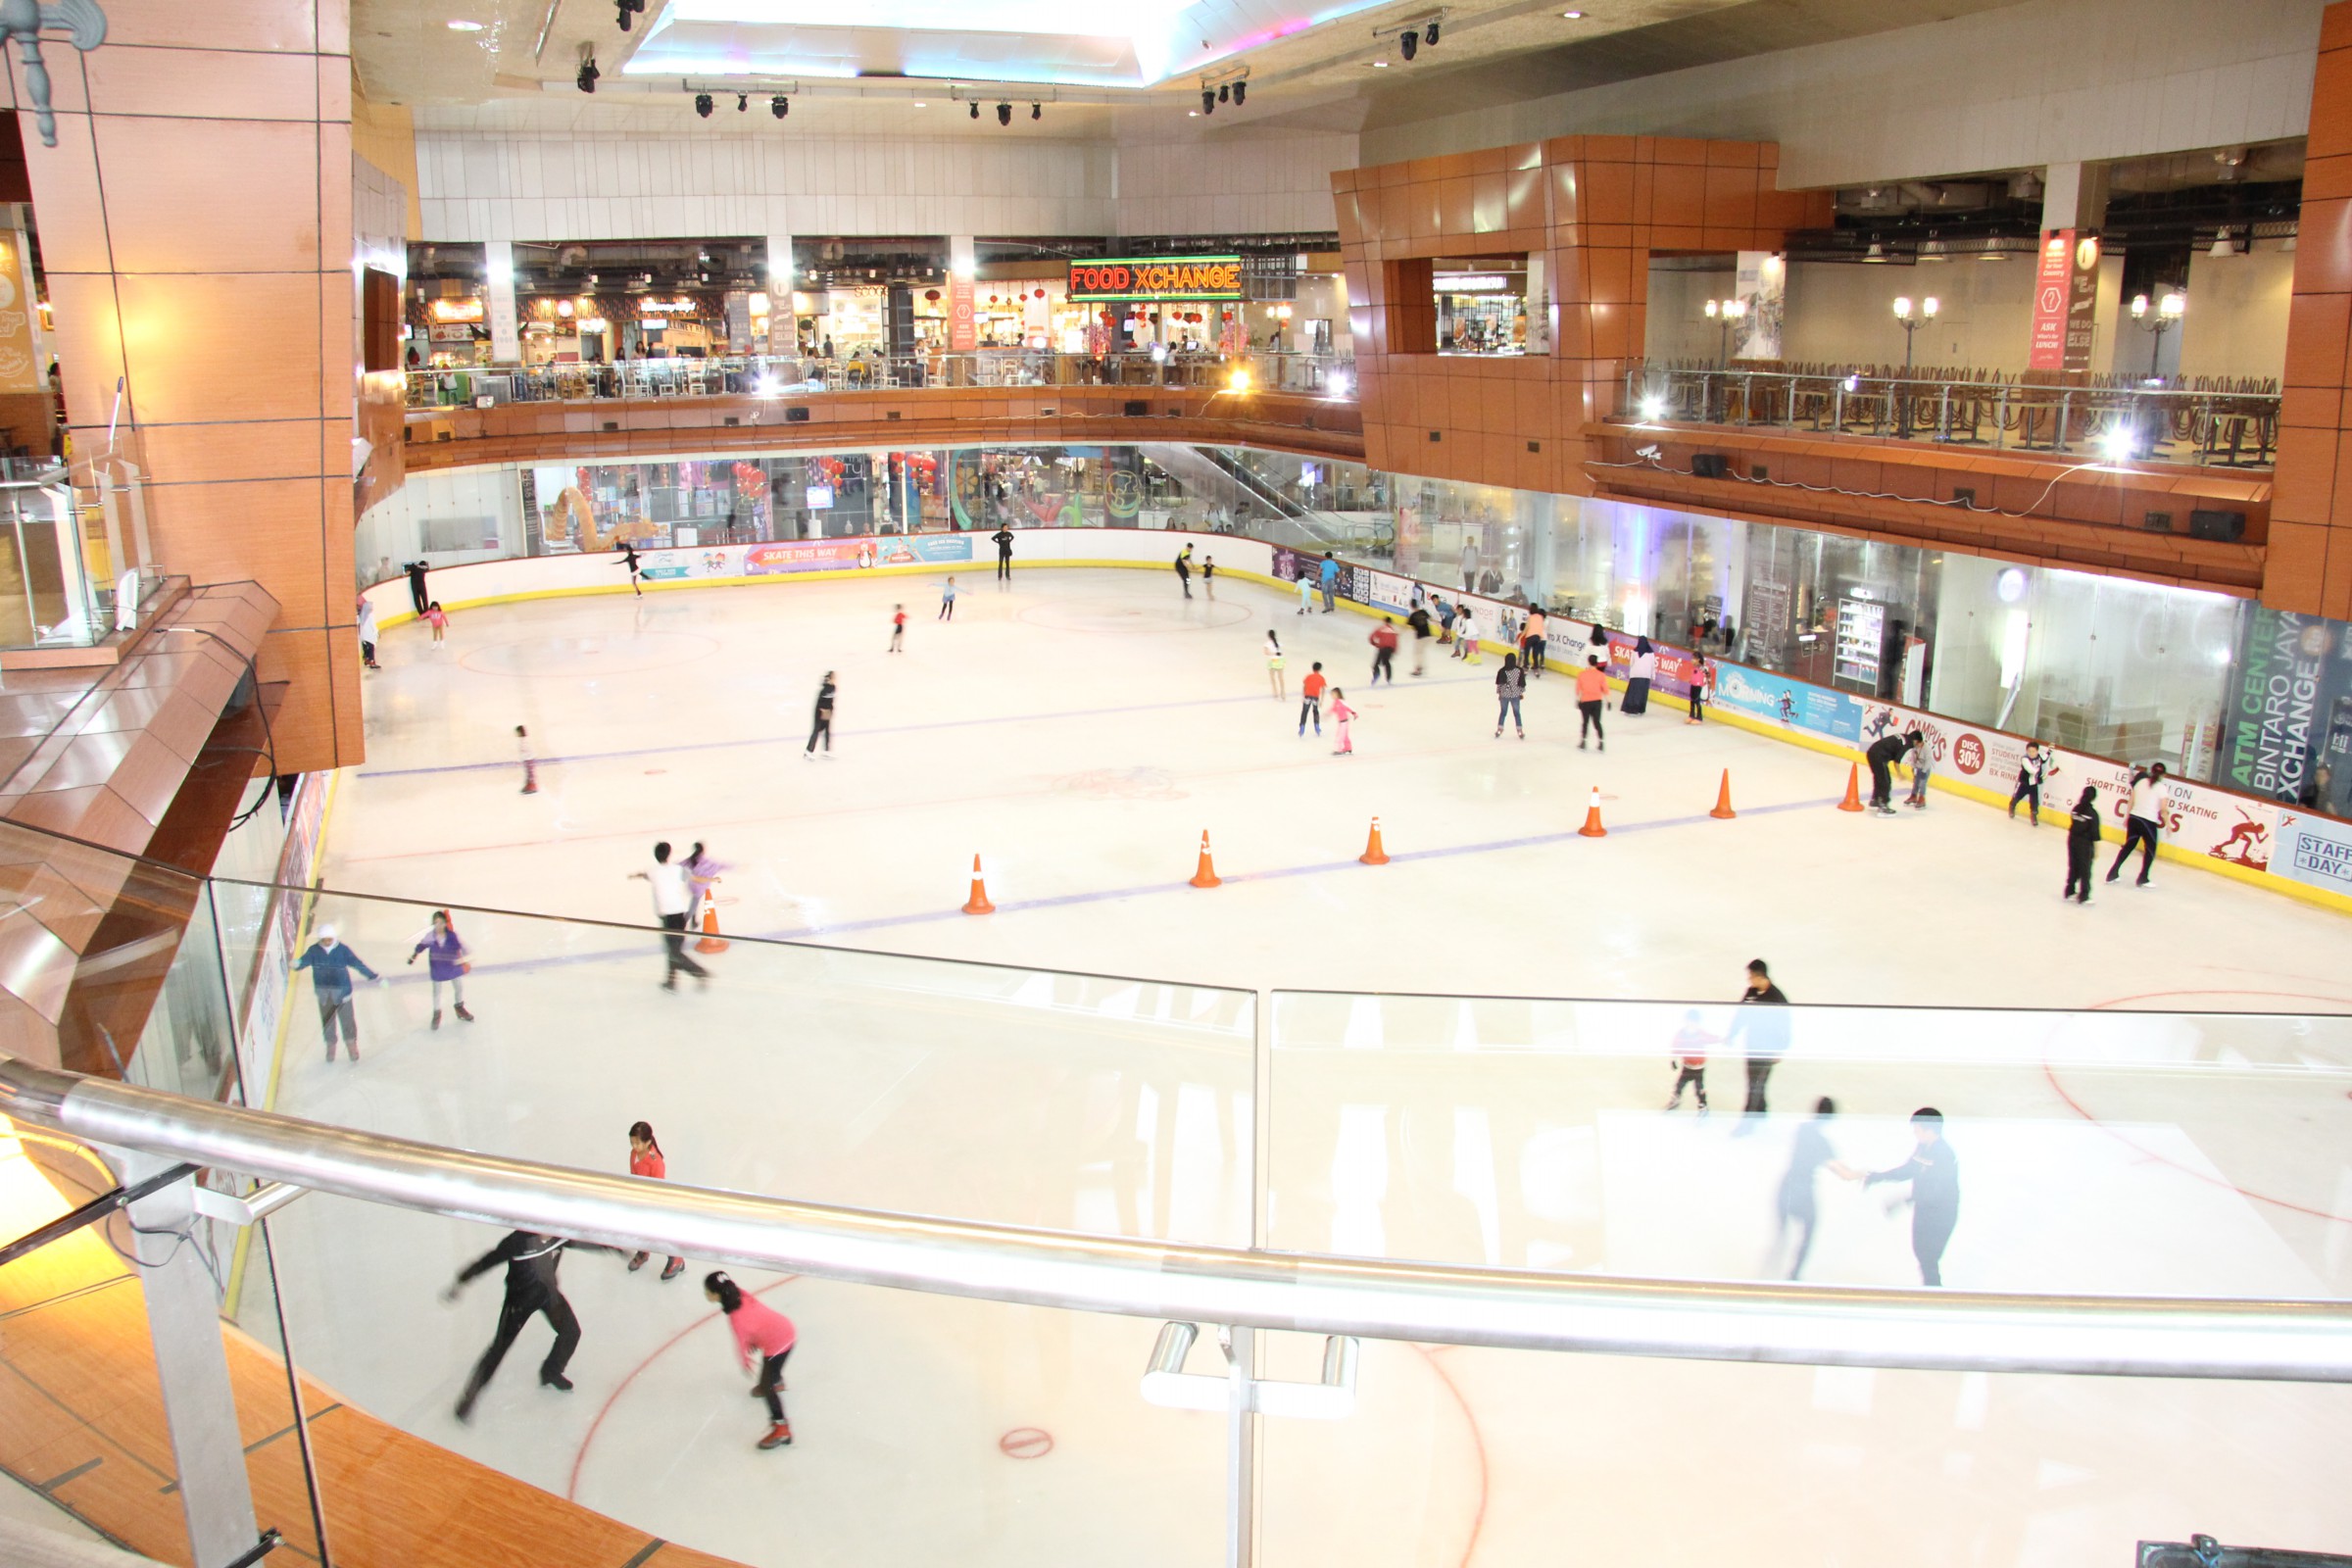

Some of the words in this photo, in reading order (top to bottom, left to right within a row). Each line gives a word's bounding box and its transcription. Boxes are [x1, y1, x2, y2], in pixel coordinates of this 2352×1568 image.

[1070, 268, 1130, 290] FOOD
[1135, 266, 1241, 289] XCHANGE
[2040, 322, 2057, 331] ASK
[763, 551, 793, 561] SKATE
[795, 549, 814, 559] THIS
[817, 547, 837, 557] WAY
[1614, 645, 1635, 660] SKAT
[1661, 658, 1680, 672] WAY
[1719, 682, 1776, 708] MORNING
[2254, 674, 2290, 792] BINTARO
[2277, 660, 2320, 801] XCHANGE
[1904, 718, 1947, 762] CAMPUS
[1961, 739, 1980, 752] DISC
[1958, 751, 1980, 769] 30%
[1991, 748, 2020, 761] STUDENT
[2231, 720, 2258, 787] ATM
[1988, 767, 1999, 777] BX
[2085, 777, 2113, 793] SHORT
[2115, 783, 2132, 797] TRA
[2177, 802, 2219, 820] SKATING
[2175, 787, 2192, 800] ON
[2300, 836, 2352, 860] STAFF
[2308, 856, 2342, 875] DAY
